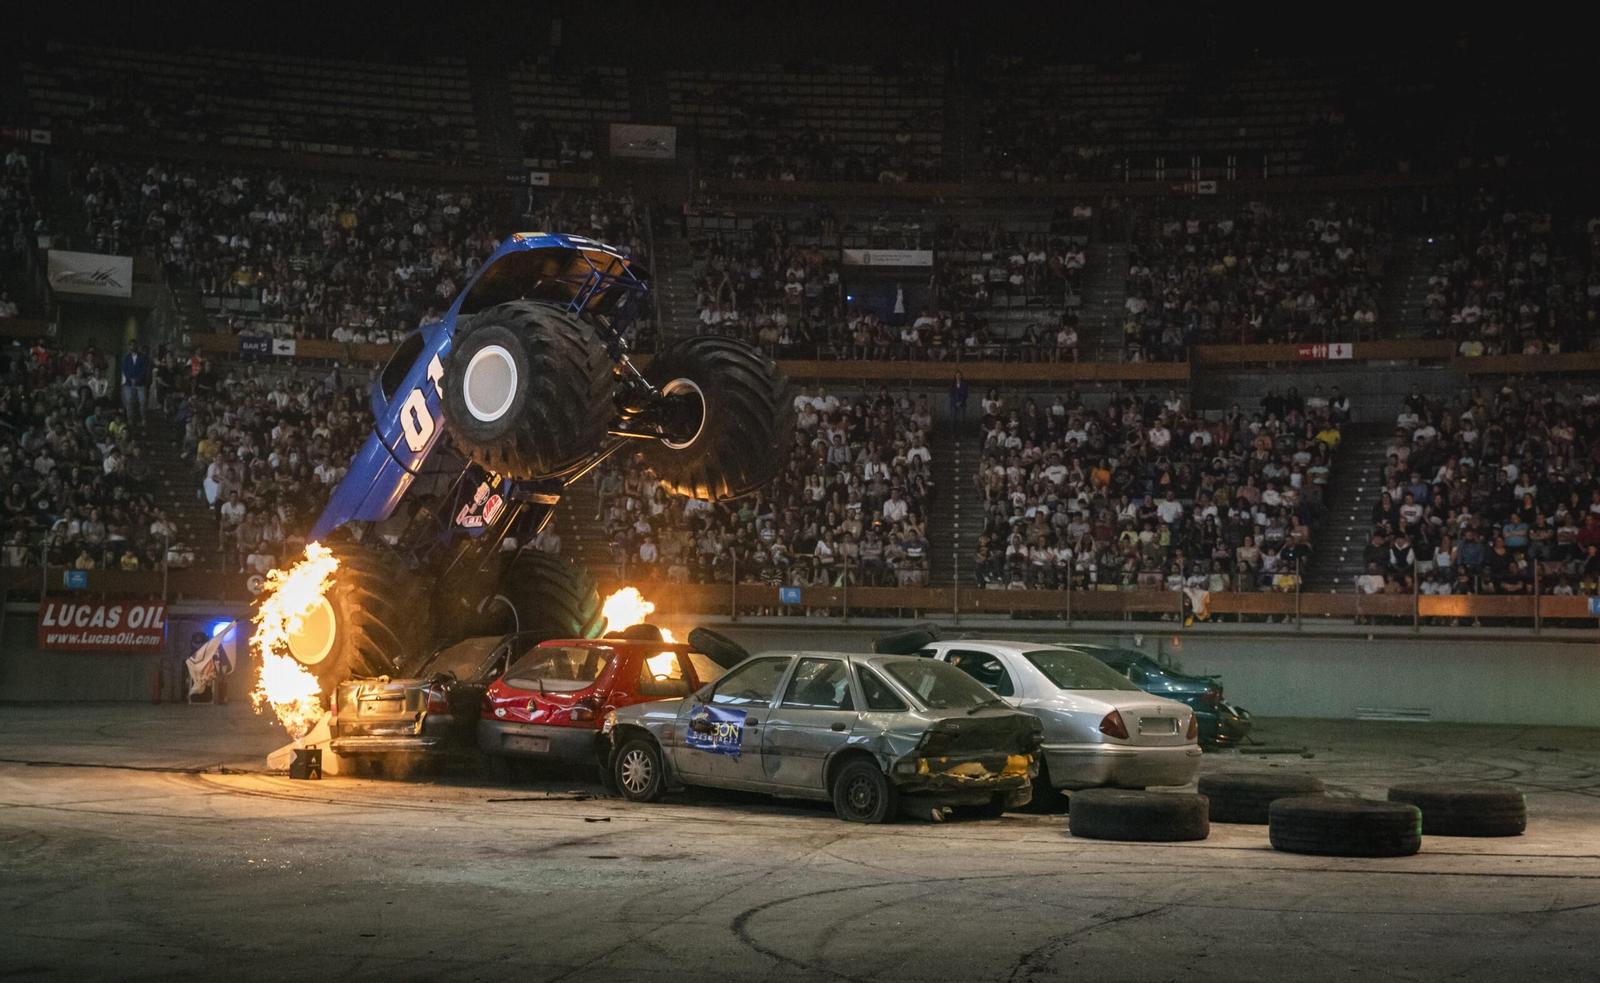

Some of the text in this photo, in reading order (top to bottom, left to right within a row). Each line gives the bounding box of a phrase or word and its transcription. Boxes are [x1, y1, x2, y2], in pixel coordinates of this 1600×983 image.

[242, 342, 259, 350] BAR
[42, 603, 164, 629] LUCAS OIL
[46, 632, 161, 646] www.LucasOil.com
